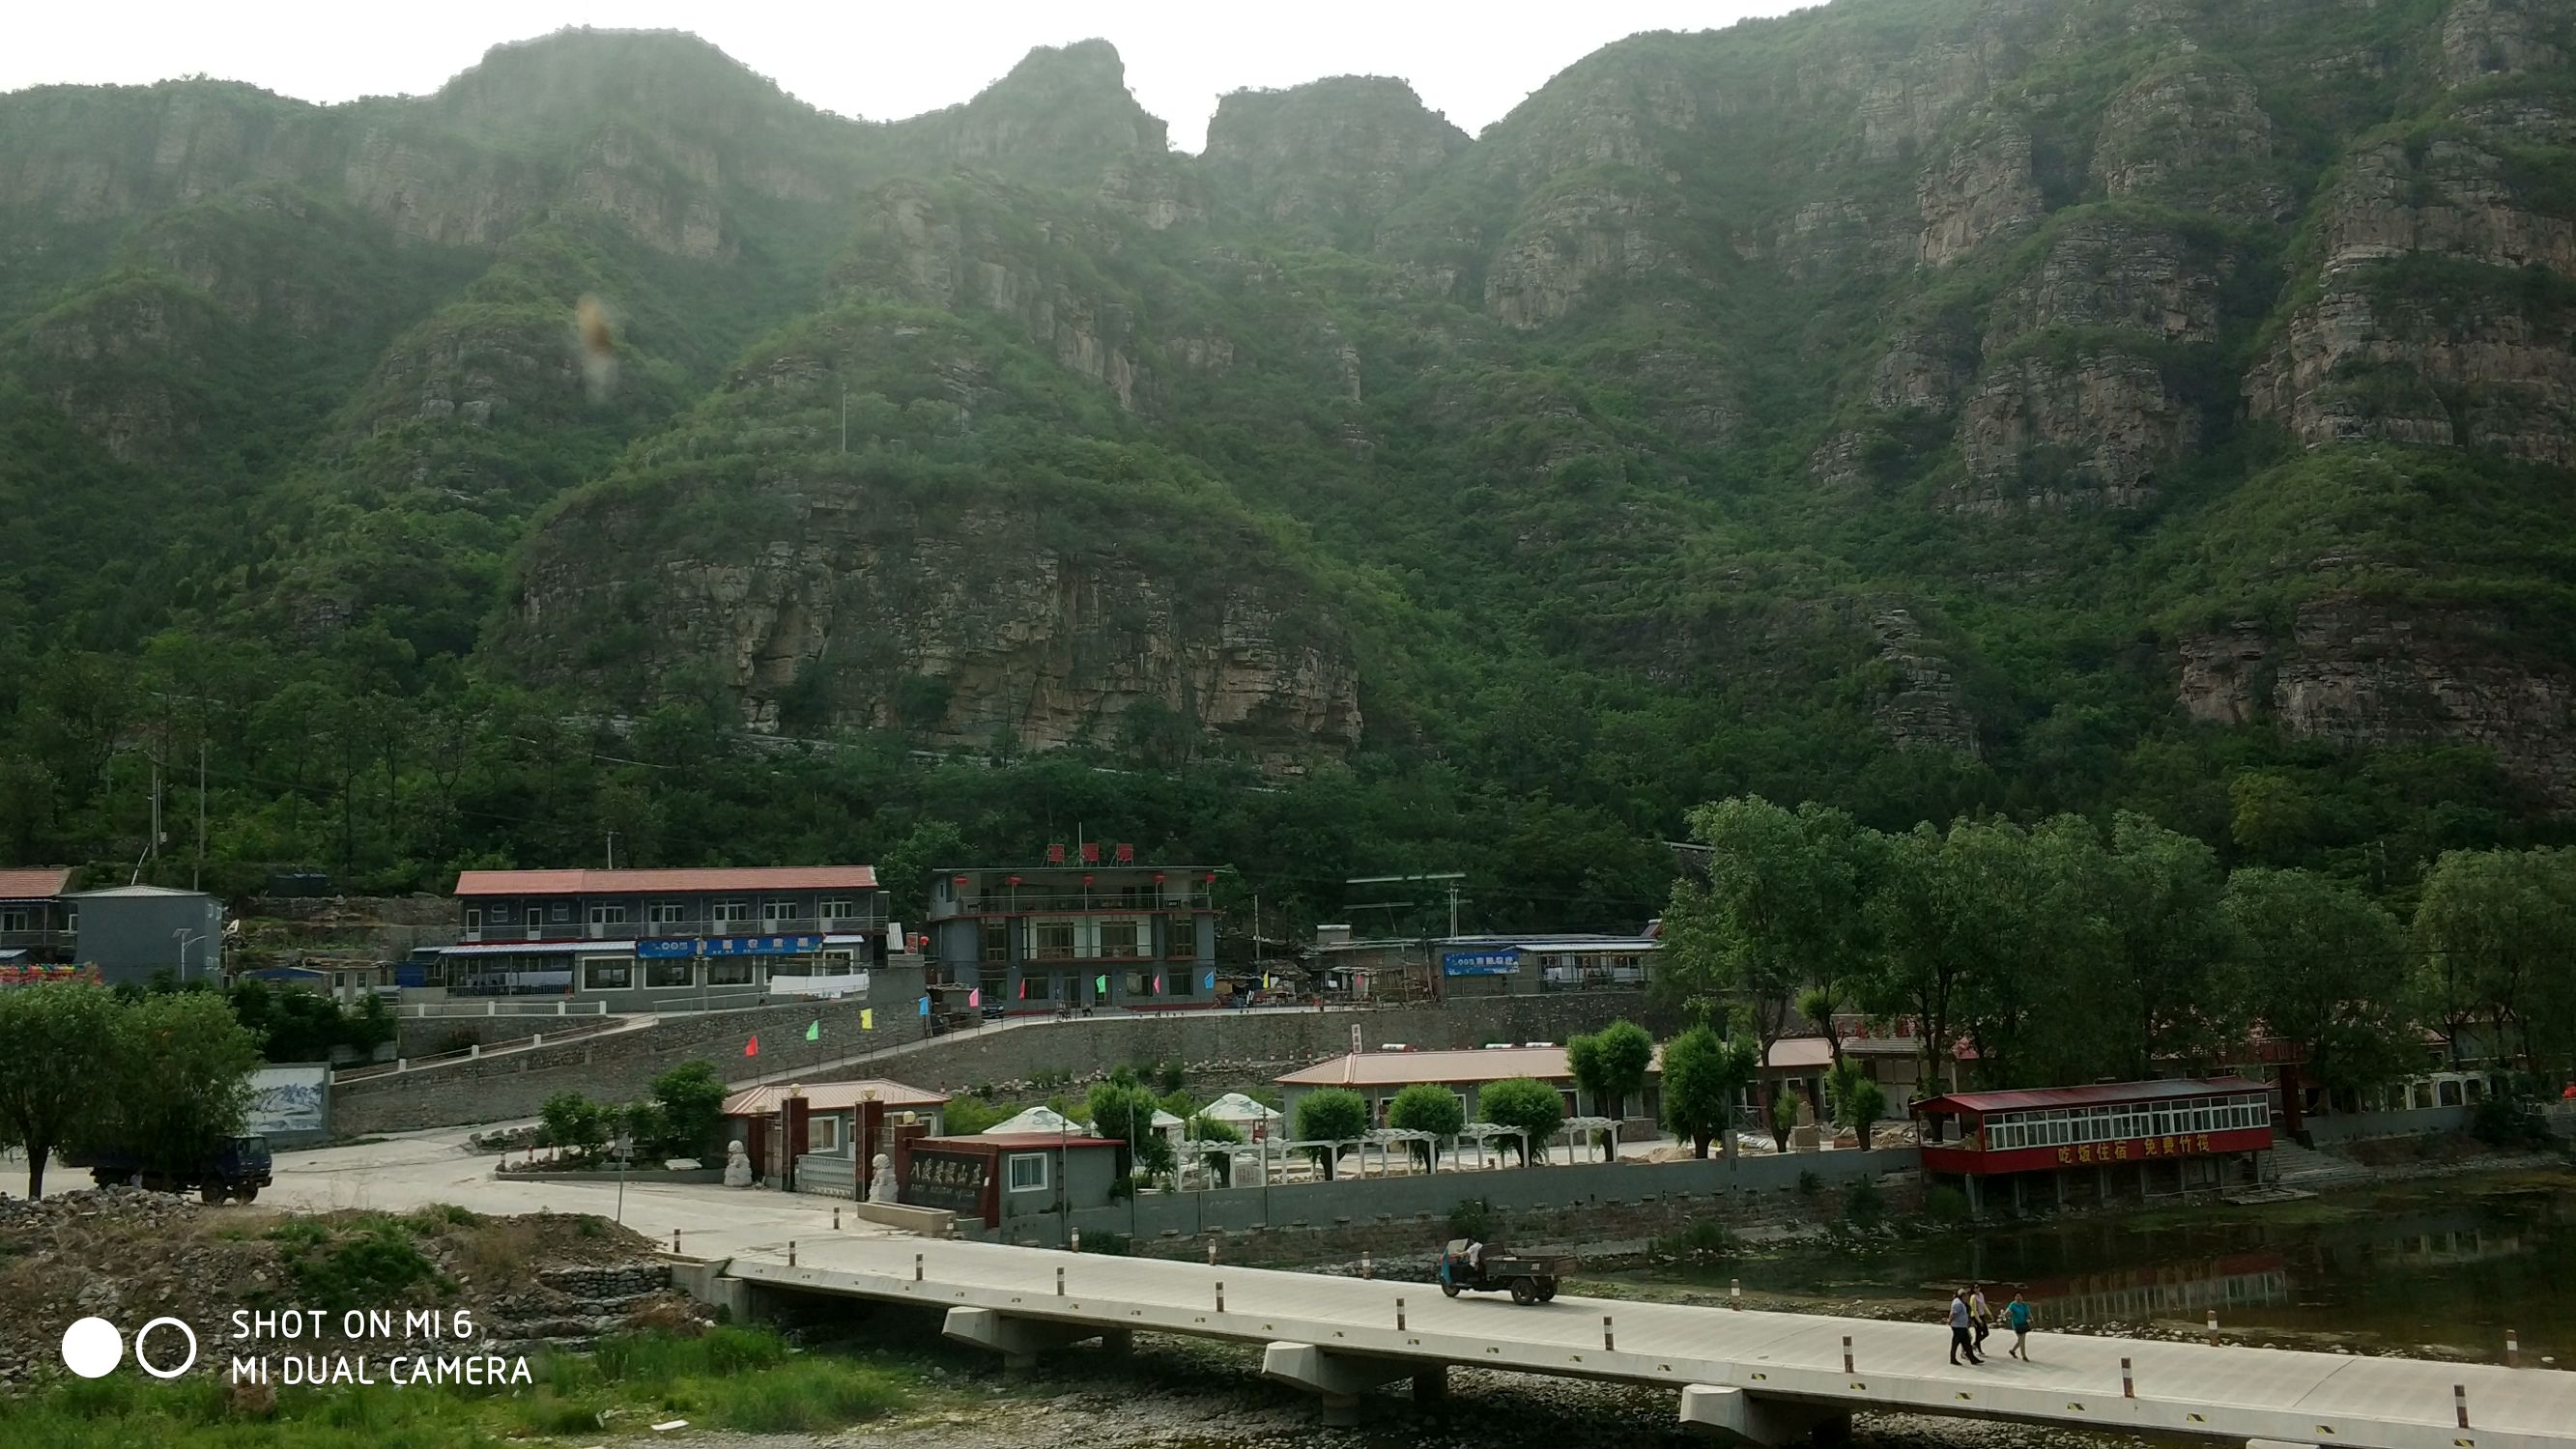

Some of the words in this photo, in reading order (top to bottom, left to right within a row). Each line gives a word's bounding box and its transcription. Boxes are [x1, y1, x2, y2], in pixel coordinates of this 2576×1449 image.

[2058, 1141, 2127, 1164] 吃饭住宿
[2144, 1134, 2210, 1155] 免费竹筏
